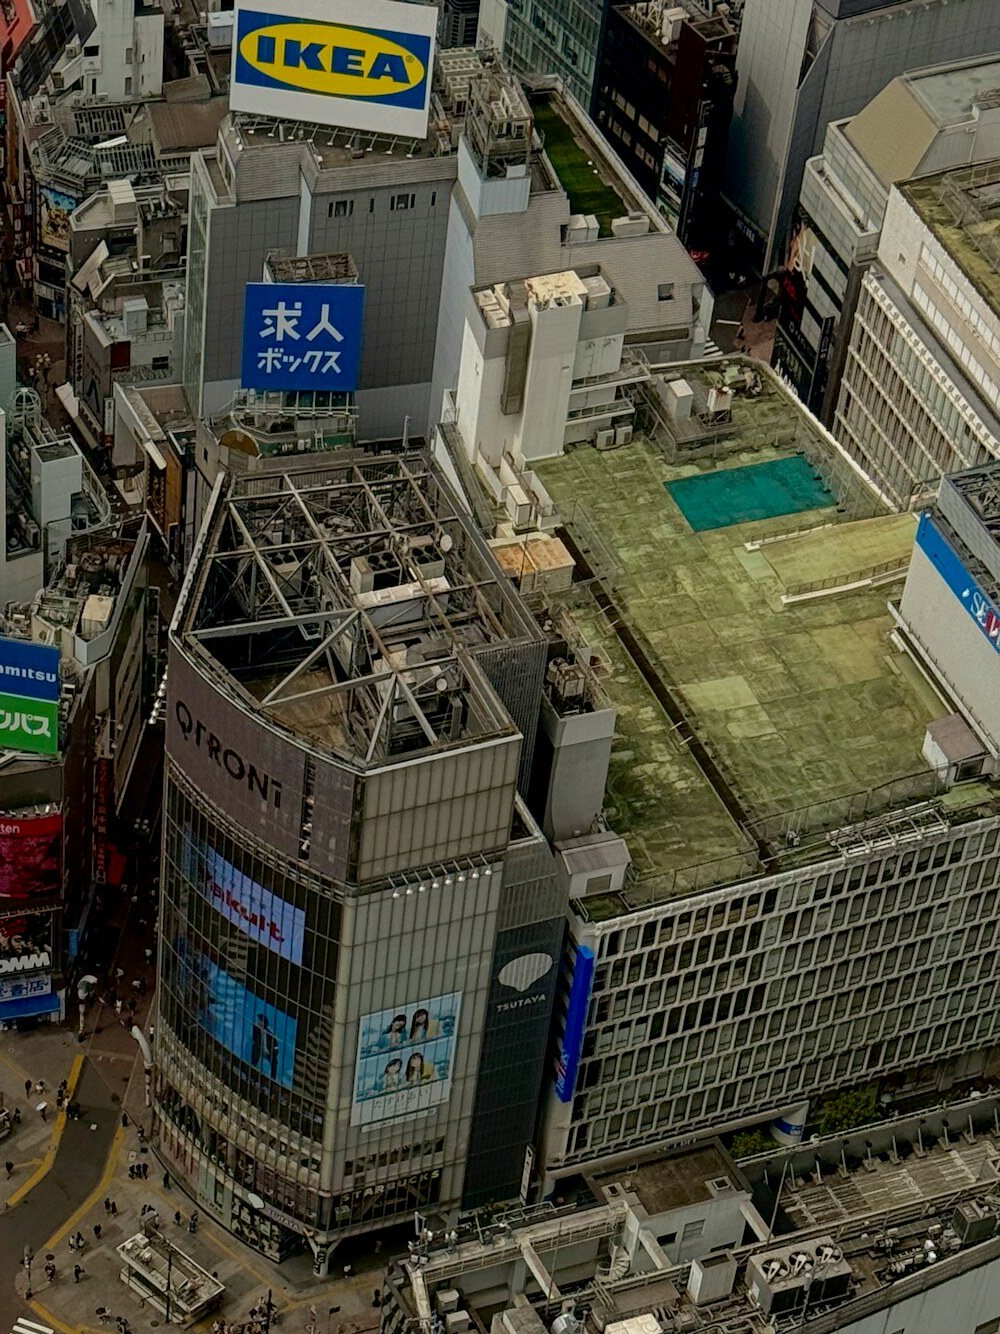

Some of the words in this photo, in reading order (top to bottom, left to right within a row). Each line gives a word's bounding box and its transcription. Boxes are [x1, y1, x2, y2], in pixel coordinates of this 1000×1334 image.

[257, 35, 411, 85] IKEA
[259, 301, 345, 342] 求人
[257, 347, 341, 374] ボックス
[496, 993, 546, 1013] TSUTAYA
[341, 1169, 440, 1203] STARBUCKS
